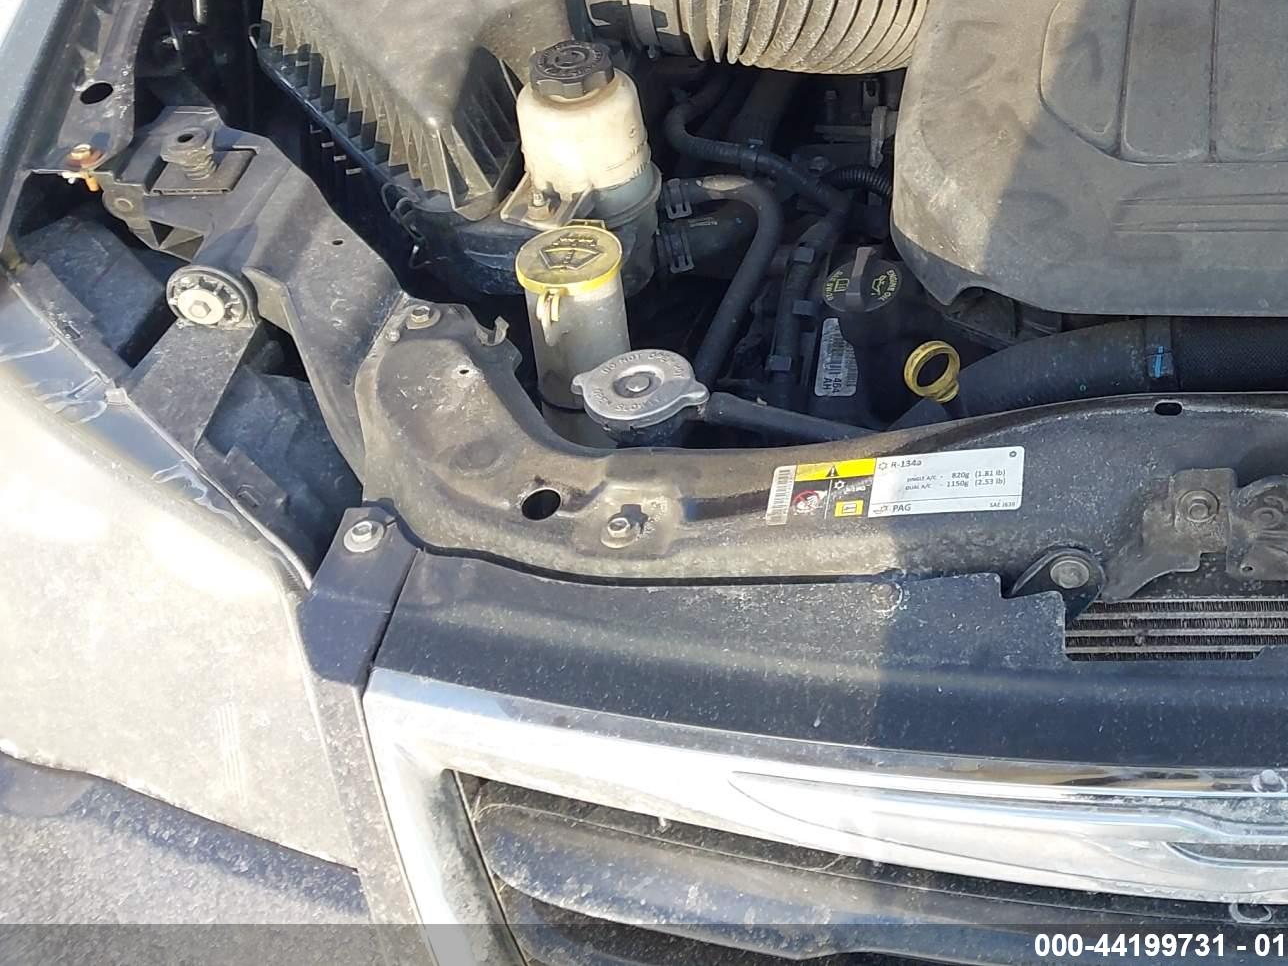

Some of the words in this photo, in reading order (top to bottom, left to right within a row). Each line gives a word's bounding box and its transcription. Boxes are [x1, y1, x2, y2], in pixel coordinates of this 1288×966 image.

[619, 353, 643, 364] NOT
[891, 459, 922, 468] R-134a
[892, 504, 911, 512] PAG
